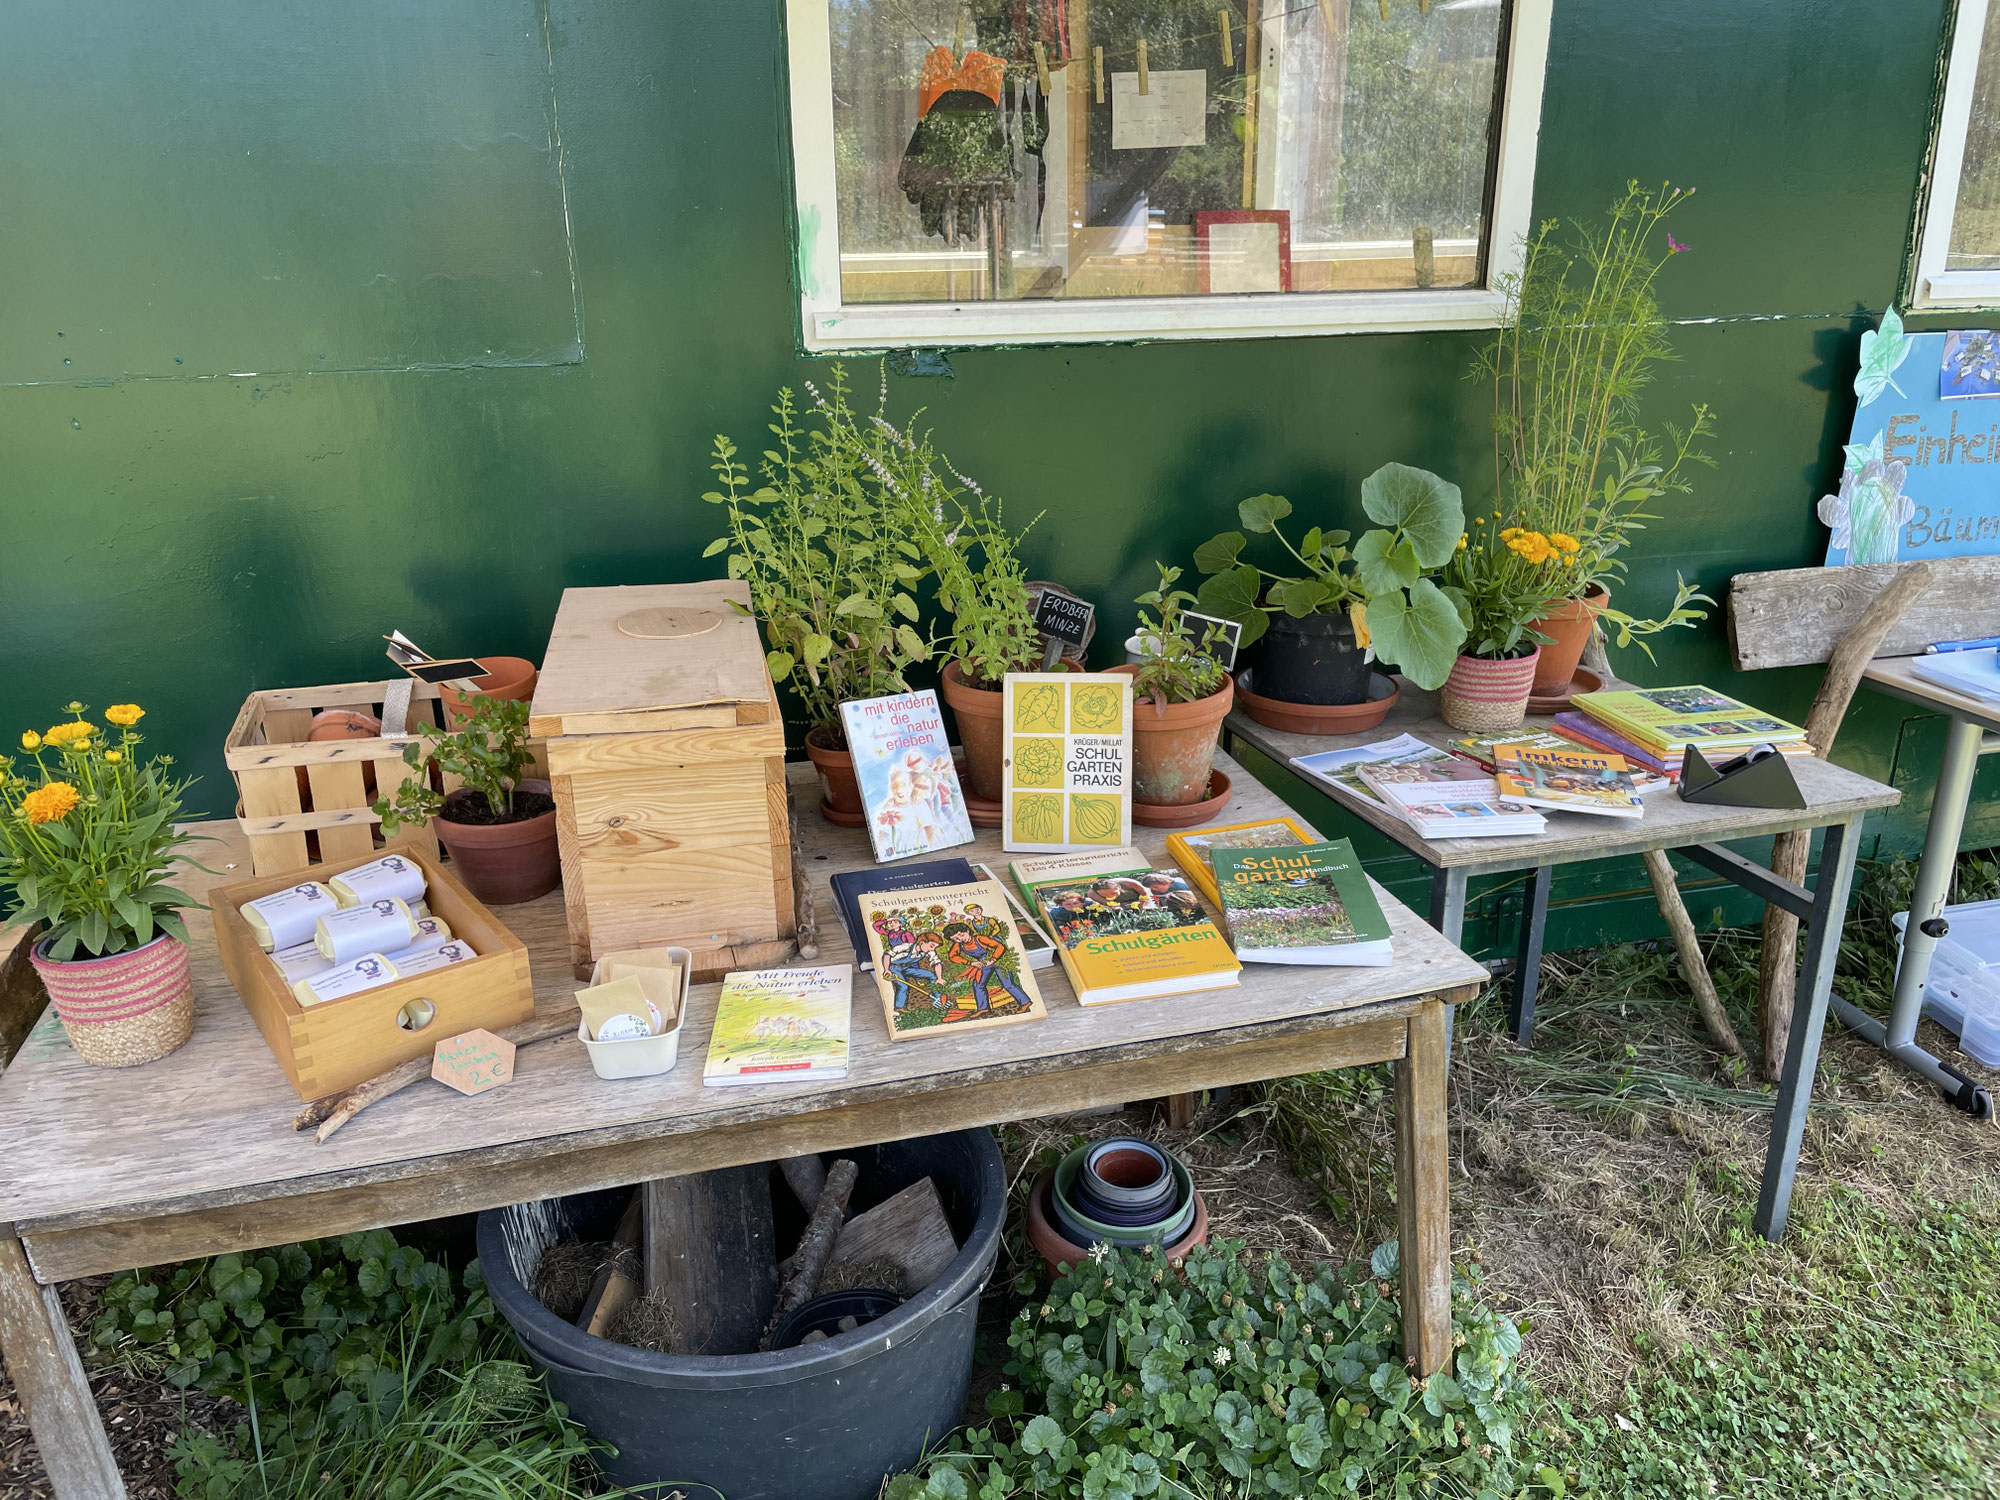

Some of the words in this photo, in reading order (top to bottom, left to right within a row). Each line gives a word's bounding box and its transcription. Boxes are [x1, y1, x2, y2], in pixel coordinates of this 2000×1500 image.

[1884, 409, 2000, 467] Einhei
[1043, 596, 1089, 622] ERDBEER
[1043, 614, 1080, 634] MINZE
[865, 702, 884, 716] mit
[886, 696, 935, 713] kindern
[890, 712, 909, 725] die
[907, 719, 939, 733] natur
[886, 734, 934, 751] erleben
[1075, 748, 1123, 760] SCHUL
[1516, 749, 1608, 767] Imkern
[1067, 760, 1122, 773] GARTEN
[1073, 774, 1122, 786] PRAXIS
[1022, 851, 1130, 868] Schulgartenunterricht
[1242, 854, 1322, 870] Schul-
[1234, 868, 1317, 885] garten
[1305, 863, 1349, 874] Handbuch
[890, 880, 950, 893] Schulgarten
[871, 888, 989, 908] Schulgartenunterricht
[946, 898, 964, 907] 3/4
[1086, 929, 1217, 955] Schulgärten
[754, 972, 779, 980] Mit
[783, 969, 825, 978] Freude
[755, 980, 794, 989] Natur
[798, 978, 842, 987] erleben
[469, 1071, 491, 1086] 2
[491, 1063, 506, 1076] €
